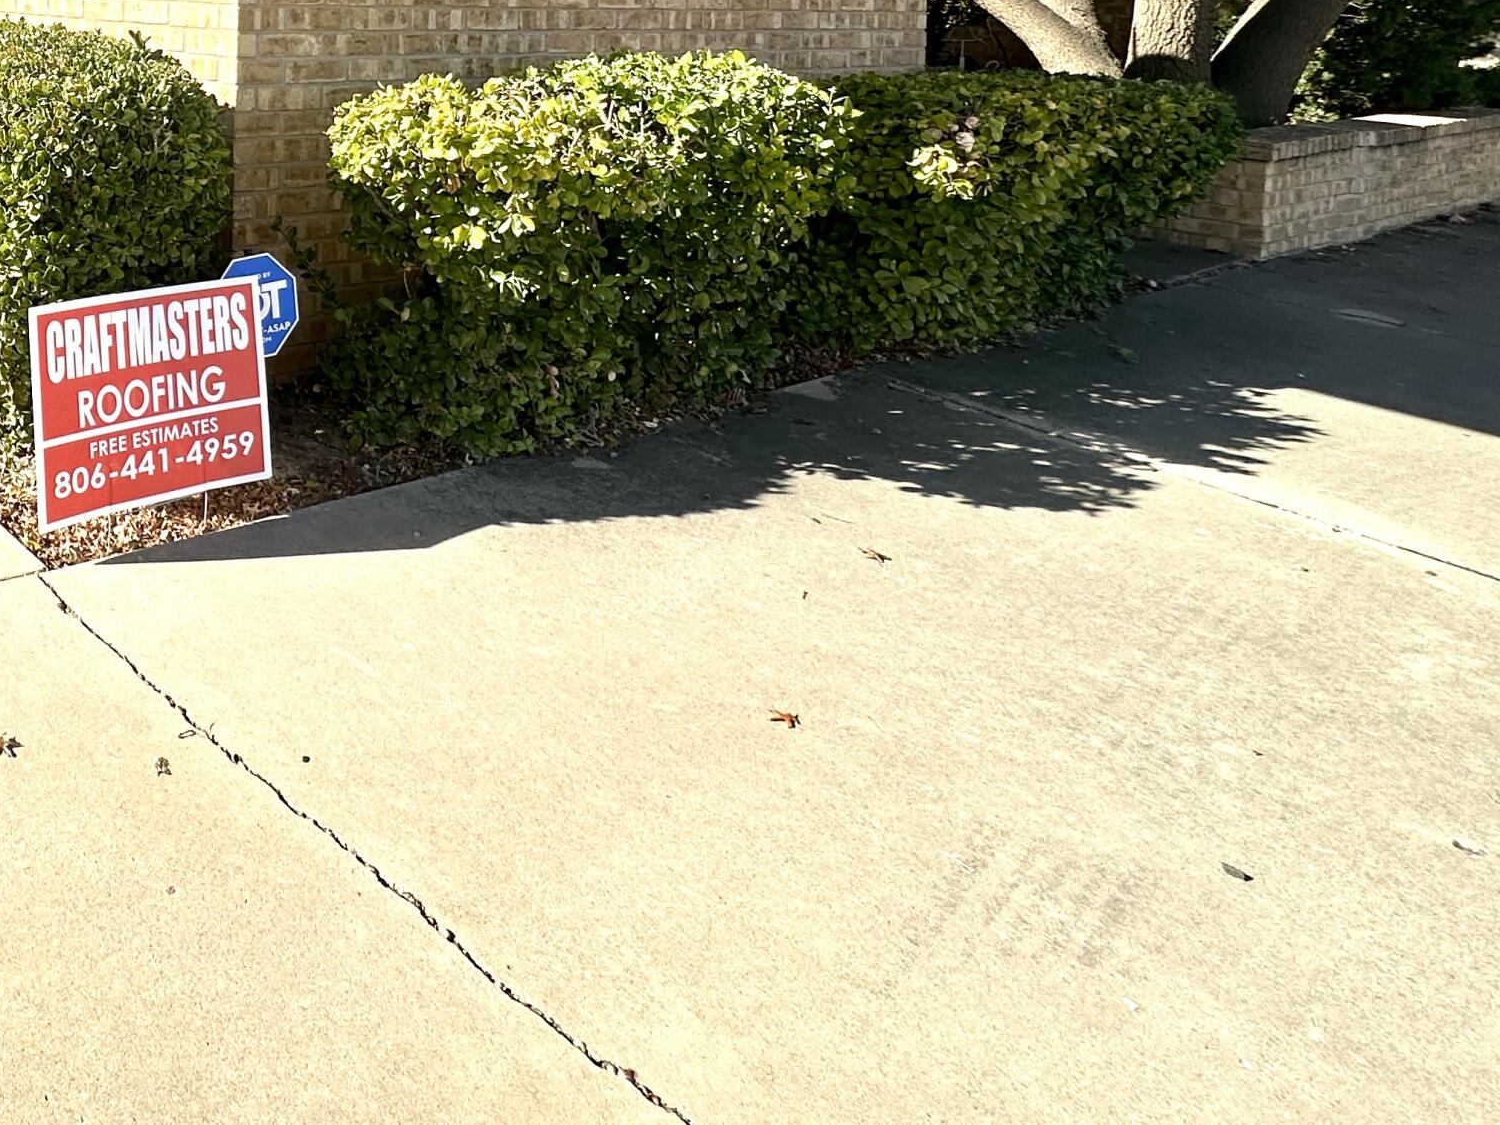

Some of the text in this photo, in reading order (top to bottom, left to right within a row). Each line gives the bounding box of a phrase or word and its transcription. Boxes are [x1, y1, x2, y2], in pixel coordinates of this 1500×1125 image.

[46, 291, 250, 384] CRAFTMASTERS
[77, 365, 227, 429] ROOFING
[53, 431, 255, 500] 806-441-4959
[89, 417, 219, 459] FREE ESTIMATES
